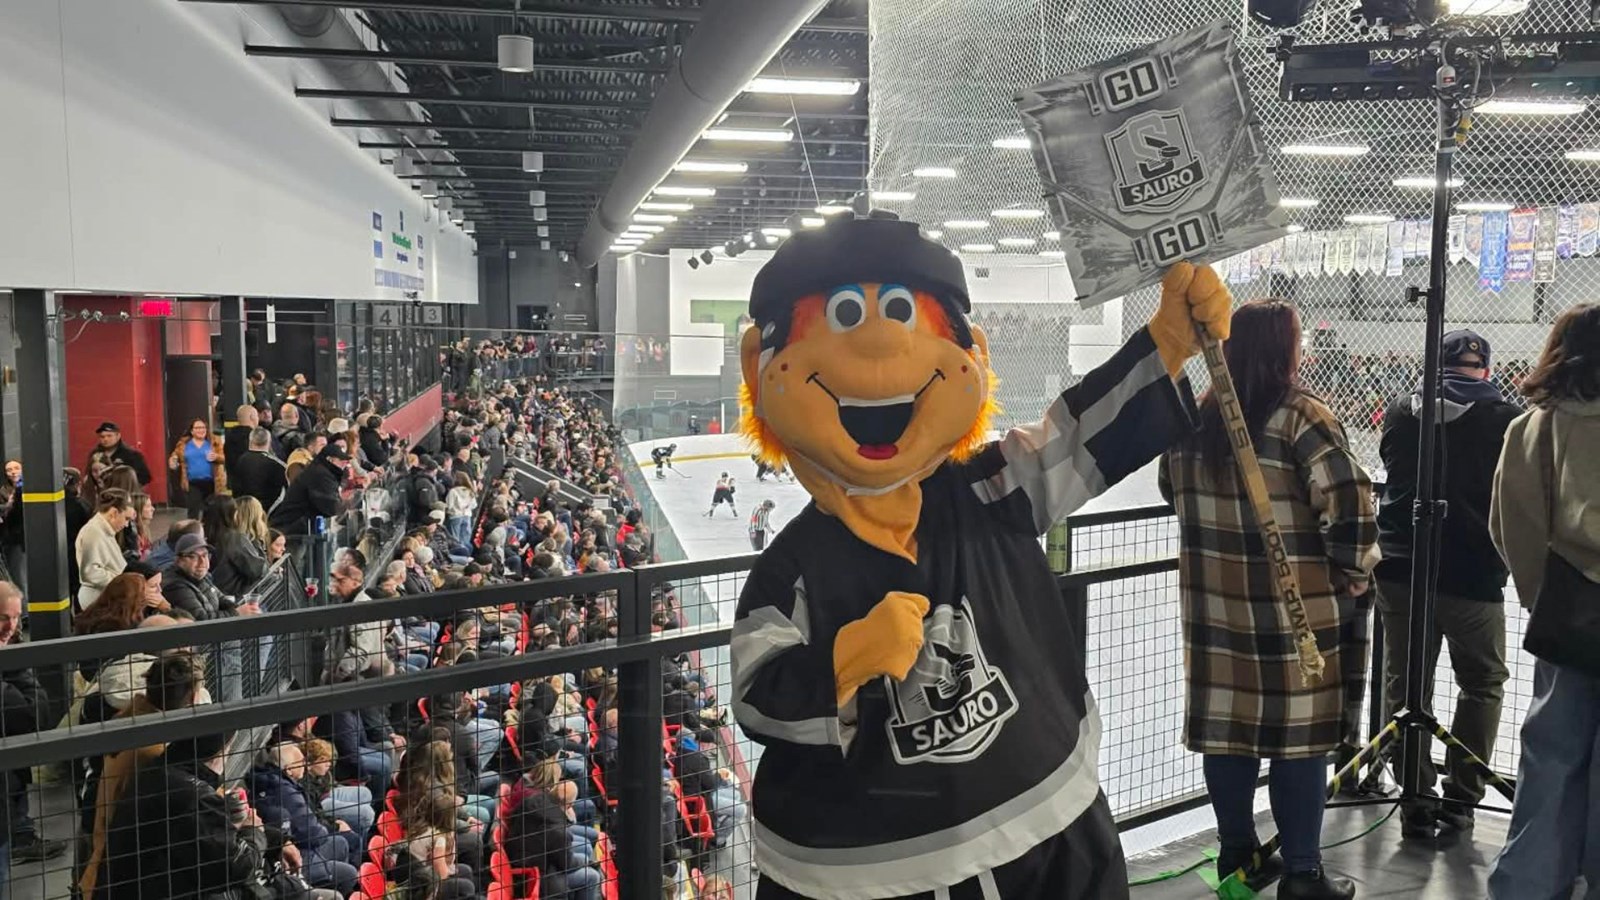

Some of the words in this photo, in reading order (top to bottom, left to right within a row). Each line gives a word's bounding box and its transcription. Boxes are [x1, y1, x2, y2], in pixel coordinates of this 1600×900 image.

[1130, 168, 1194, 205] SAURO
[380, 309, 392, 325] 4
[428, 308, 437, 320] 3
[911, 690, 998, 751] SAURO
